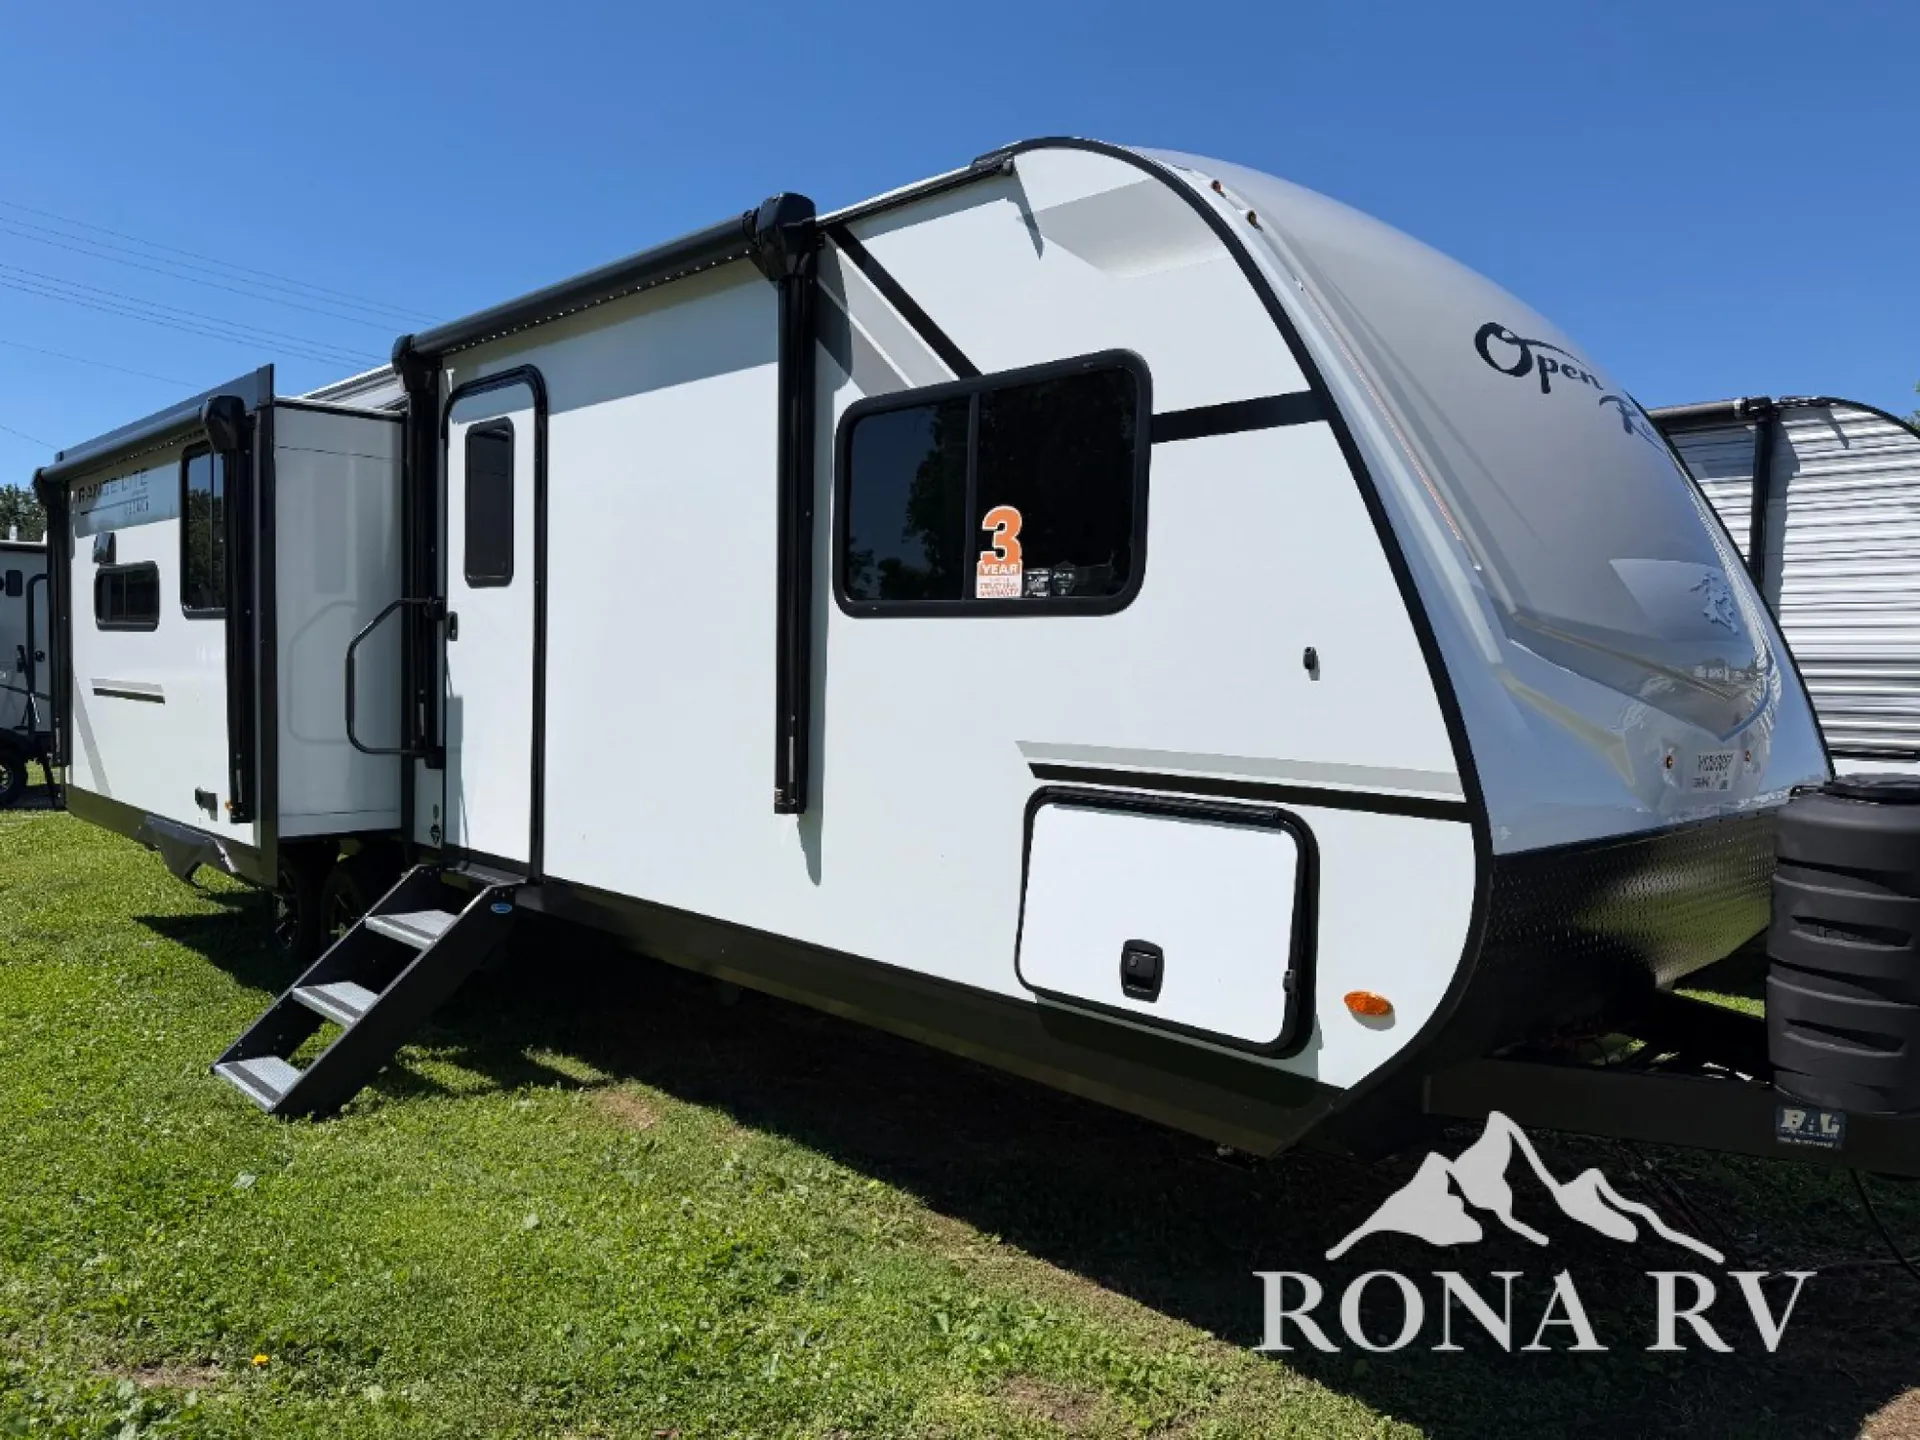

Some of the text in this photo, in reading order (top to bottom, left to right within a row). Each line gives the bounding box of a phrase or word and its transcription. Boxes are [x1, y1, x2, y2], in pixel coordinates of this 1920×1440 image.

[1474, 321, 1604, 394] Open
[981, 505, 1022, 563] 3
[981, 563, 1019, 575] YEAR
